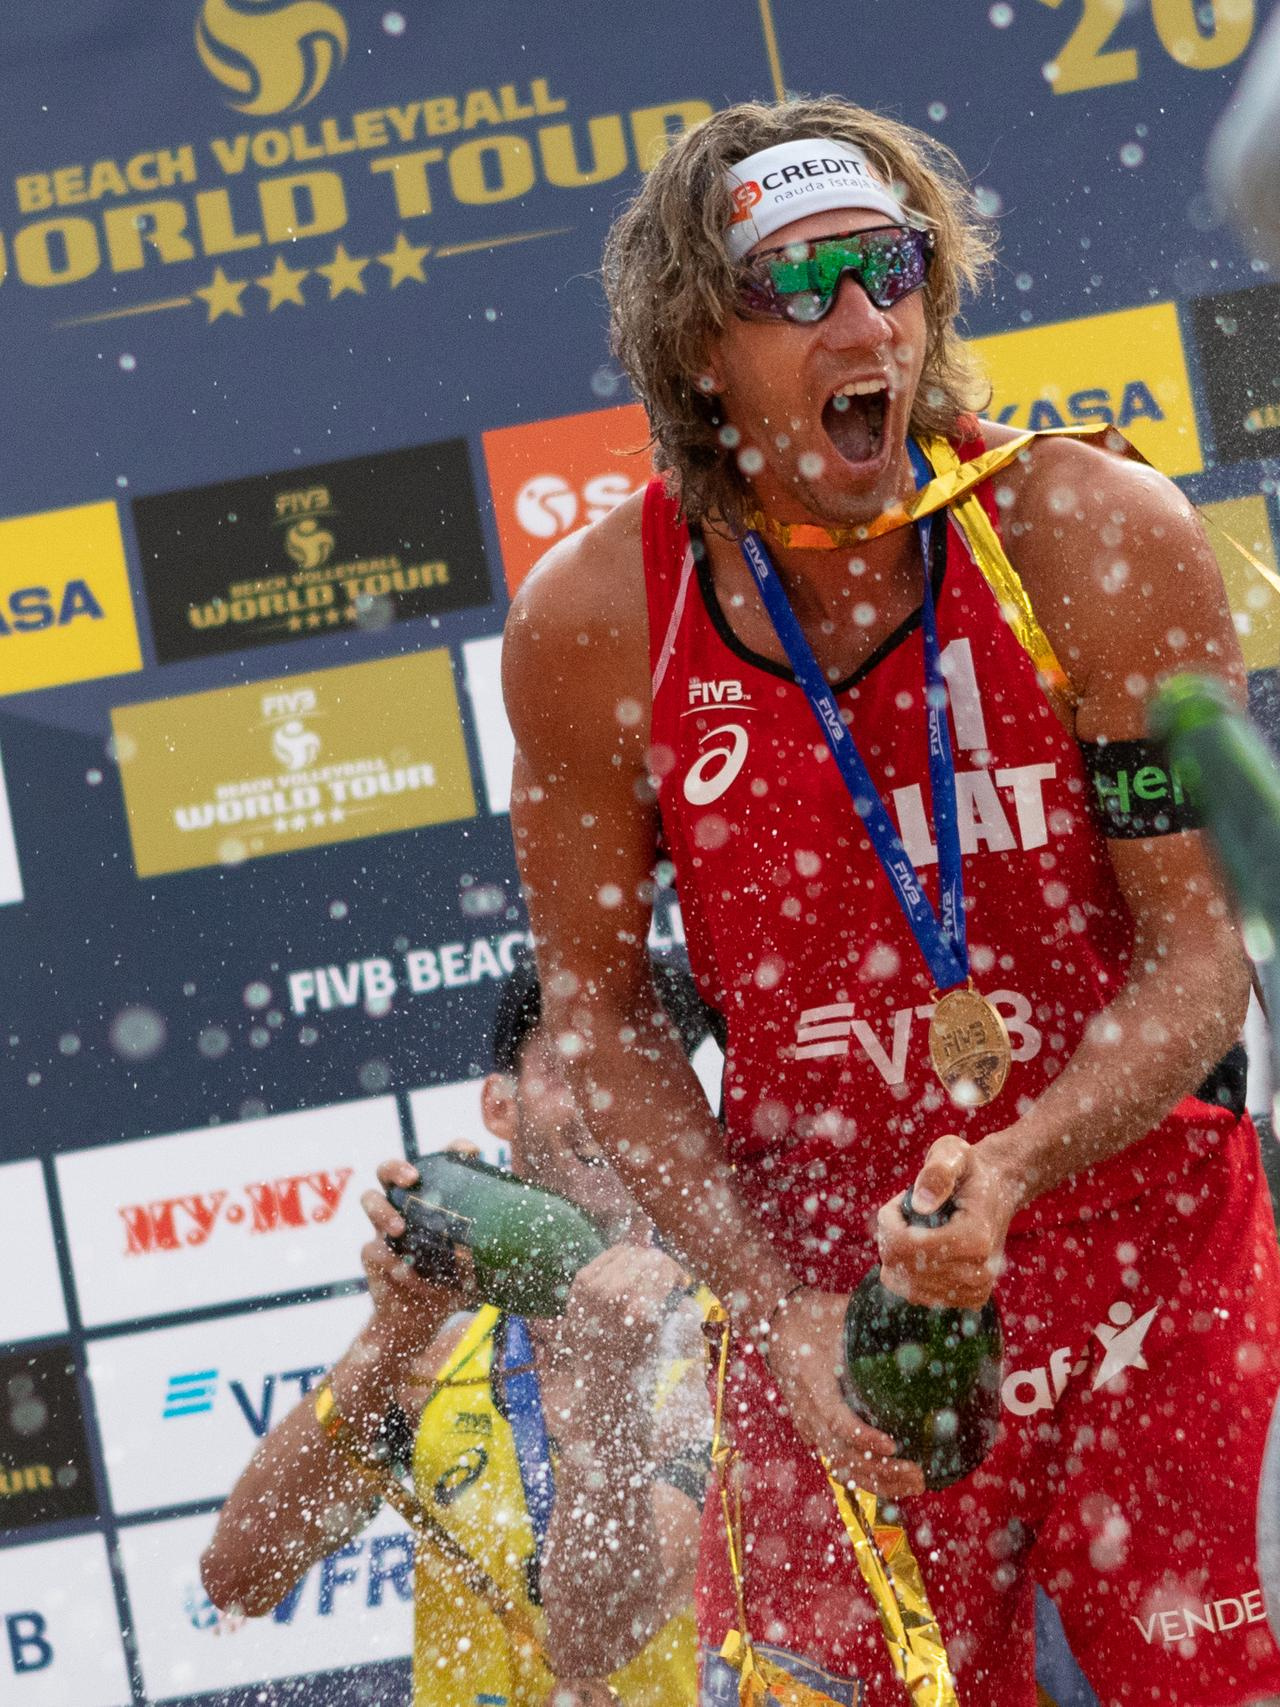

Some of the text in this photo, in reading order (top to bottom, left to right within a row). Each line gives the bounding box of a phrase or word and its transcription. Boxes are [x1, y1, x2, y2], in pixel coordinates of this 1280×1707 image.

[15, 79, 567, 214] BEACH VOLLEYBALL
[0, 170, 348, 288] ORLD
[774, 182, 825, 203] nauda
[0, 578, 105, 635] SA
[188, 561, 449, 629] WORLD TOUR
[688, 679, 743, 704] FIVB
[937, 637, 988, 750] 1
[175, 763, 436, 832] WORLD TOUR
[893, 762, 1056, 867] LAT
[288, 930, 534, 1014] FIVB BEAC
[851, 989, 1041, 1085] VB
[1130, 1589, 1268, 1644] VENDE
